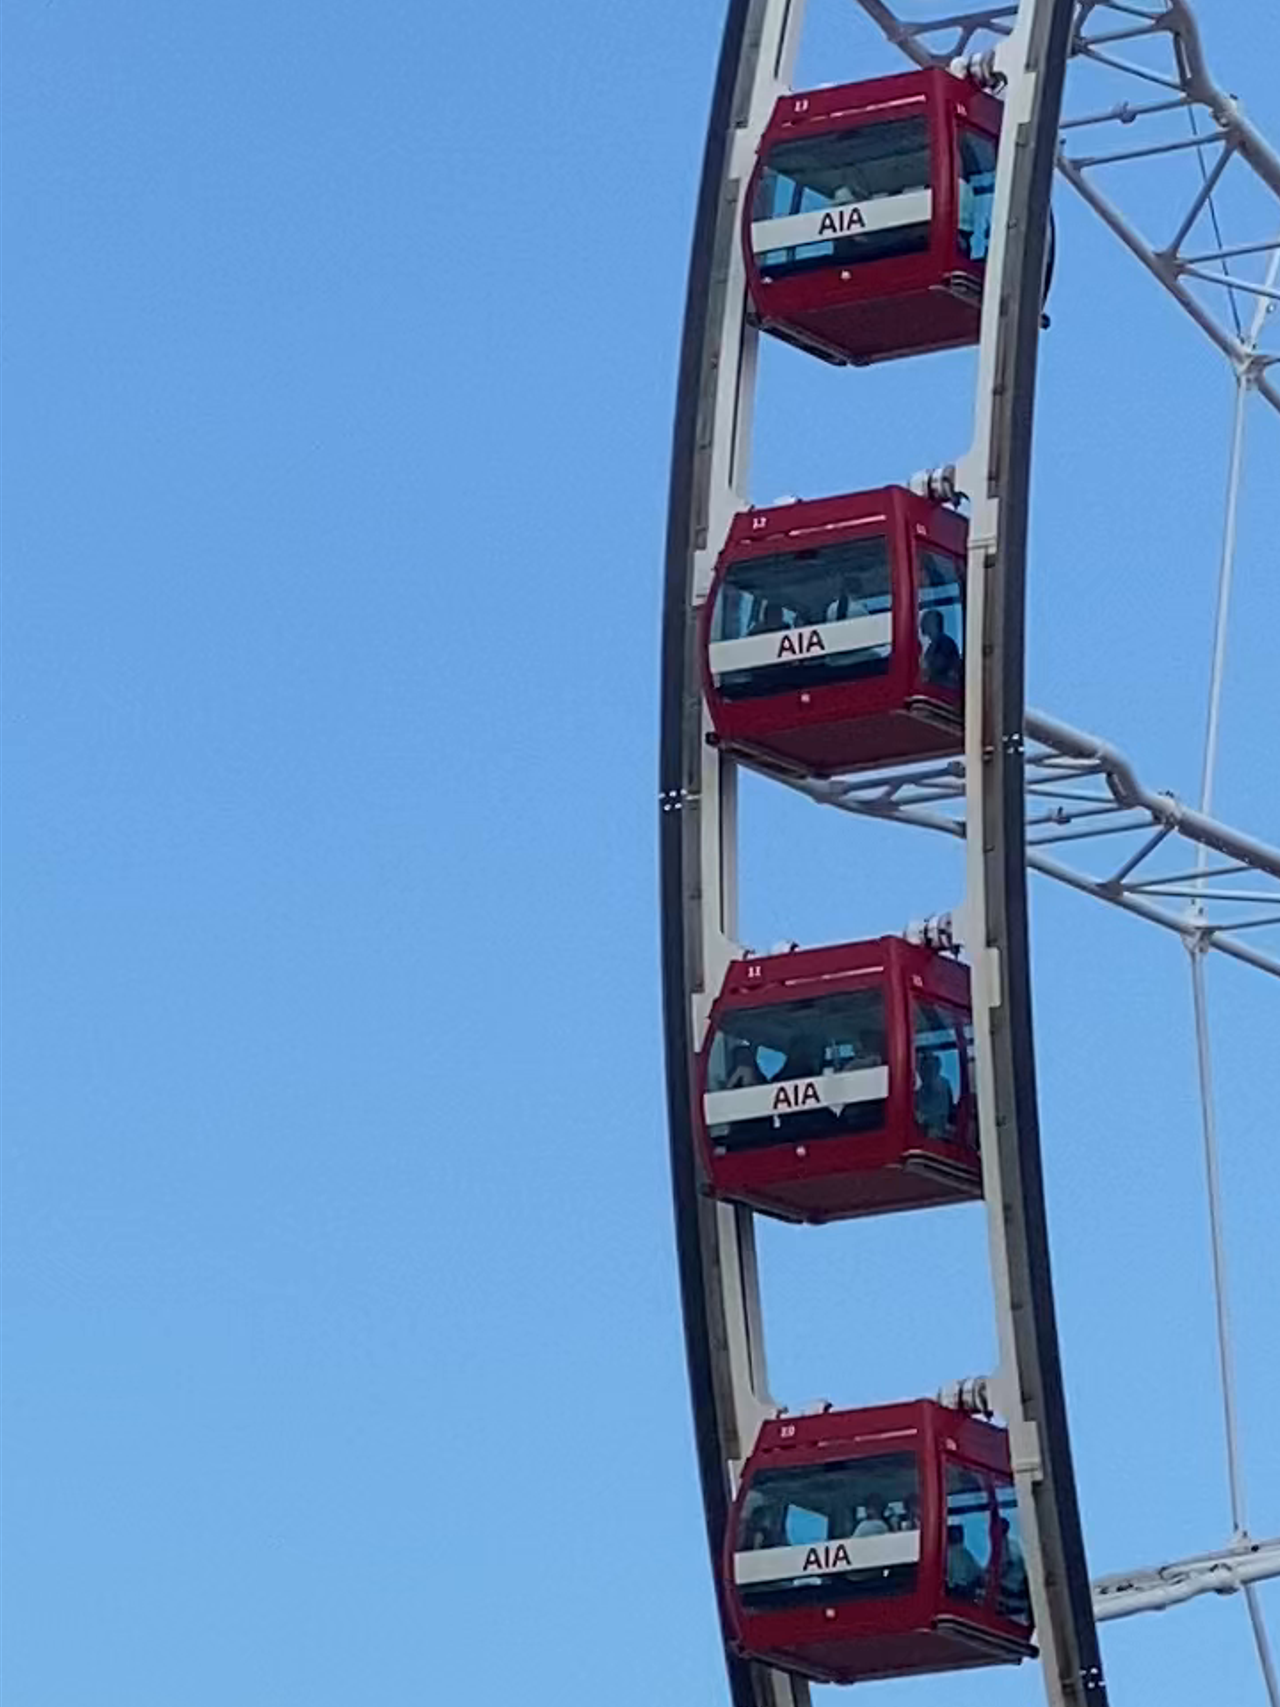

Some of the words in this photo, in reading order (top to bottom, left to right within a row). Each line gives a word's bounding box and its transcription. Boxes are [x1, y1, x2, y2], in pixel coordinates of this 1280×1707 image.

[817, 208, 866, 236] AIA
[777, 630, 826, 658] AIA
[772, 1082, 821, 1110] AIA
[802, 1543, 852, 1571] AIA
